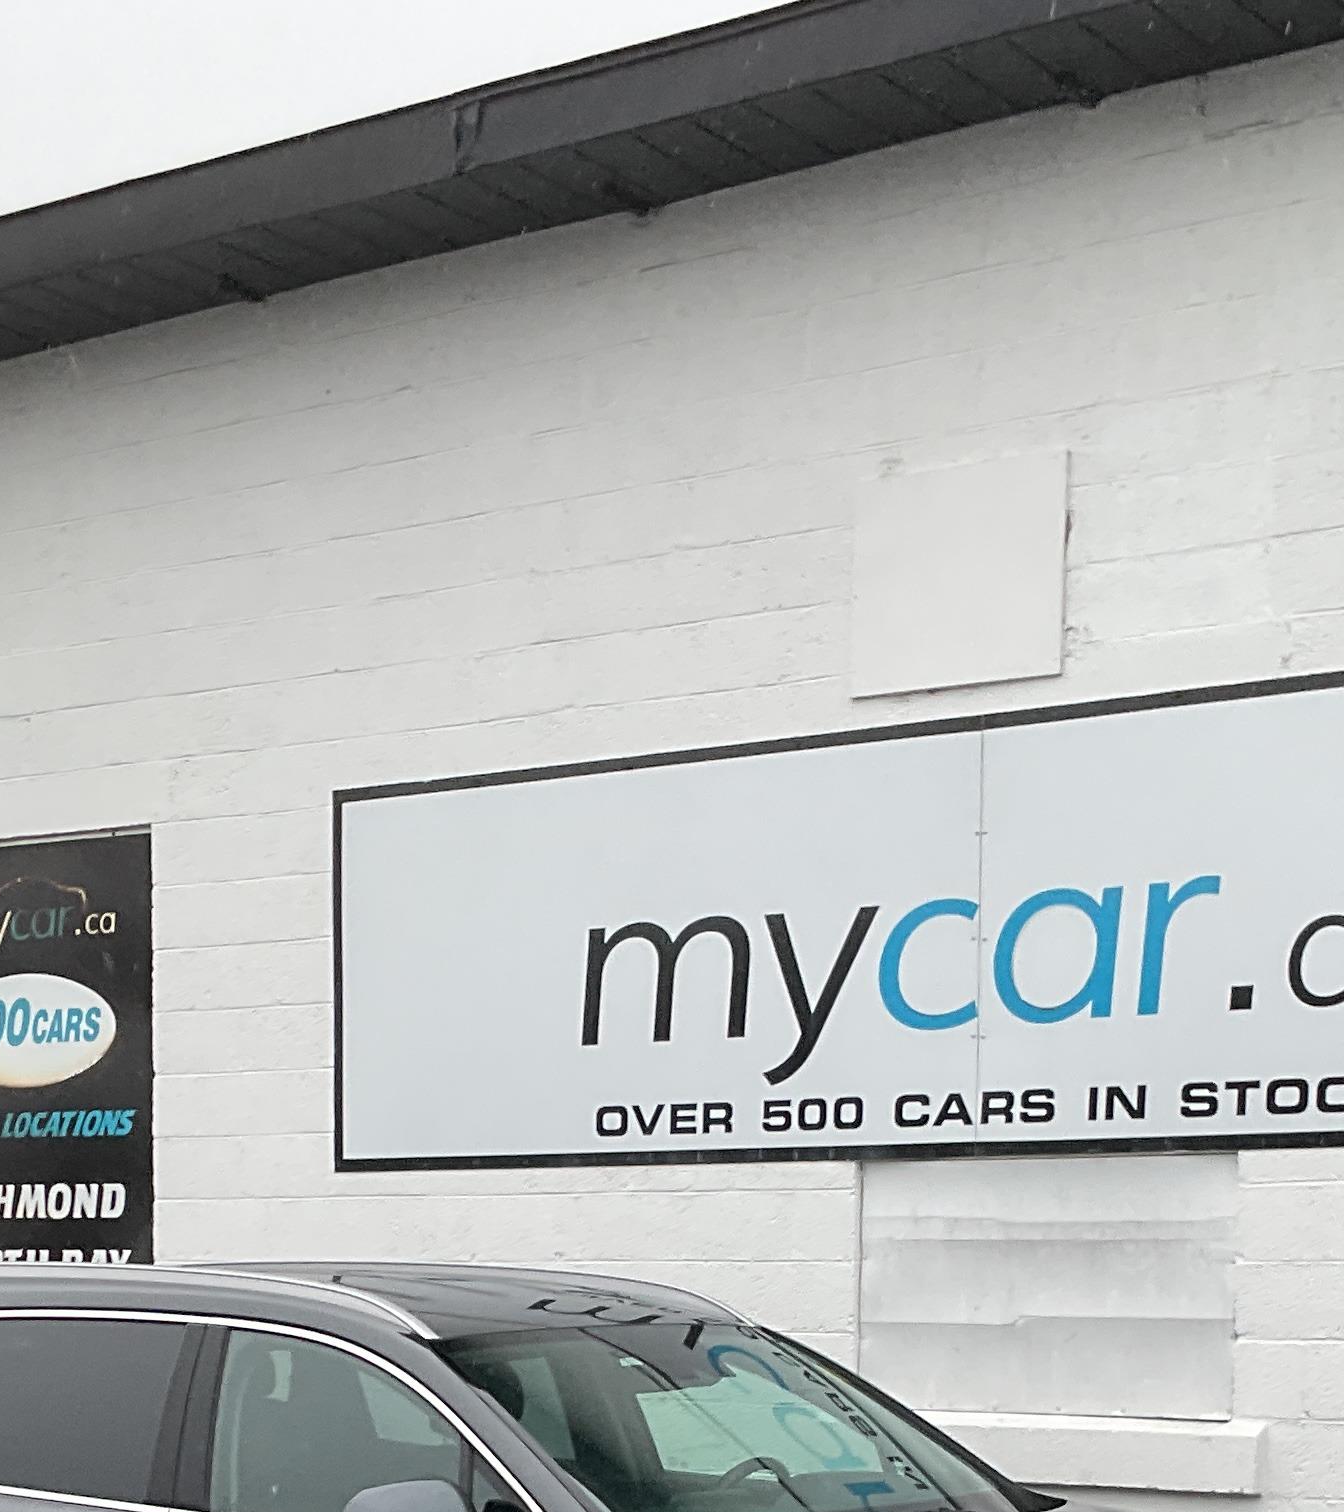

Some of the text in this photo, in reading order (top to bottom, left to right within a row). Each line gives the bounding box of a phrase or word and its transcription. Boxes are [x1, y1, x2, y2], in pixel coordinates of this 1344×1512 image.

[1, 1109, 137, 1138] LOCATIONS
[594, 1102, 734, 1138] OVER
[761, 1096, 864, 1132] 500
[894, 1088, 1056, 1128] CARS
[1088, 1084, 1148, 1121] IN
